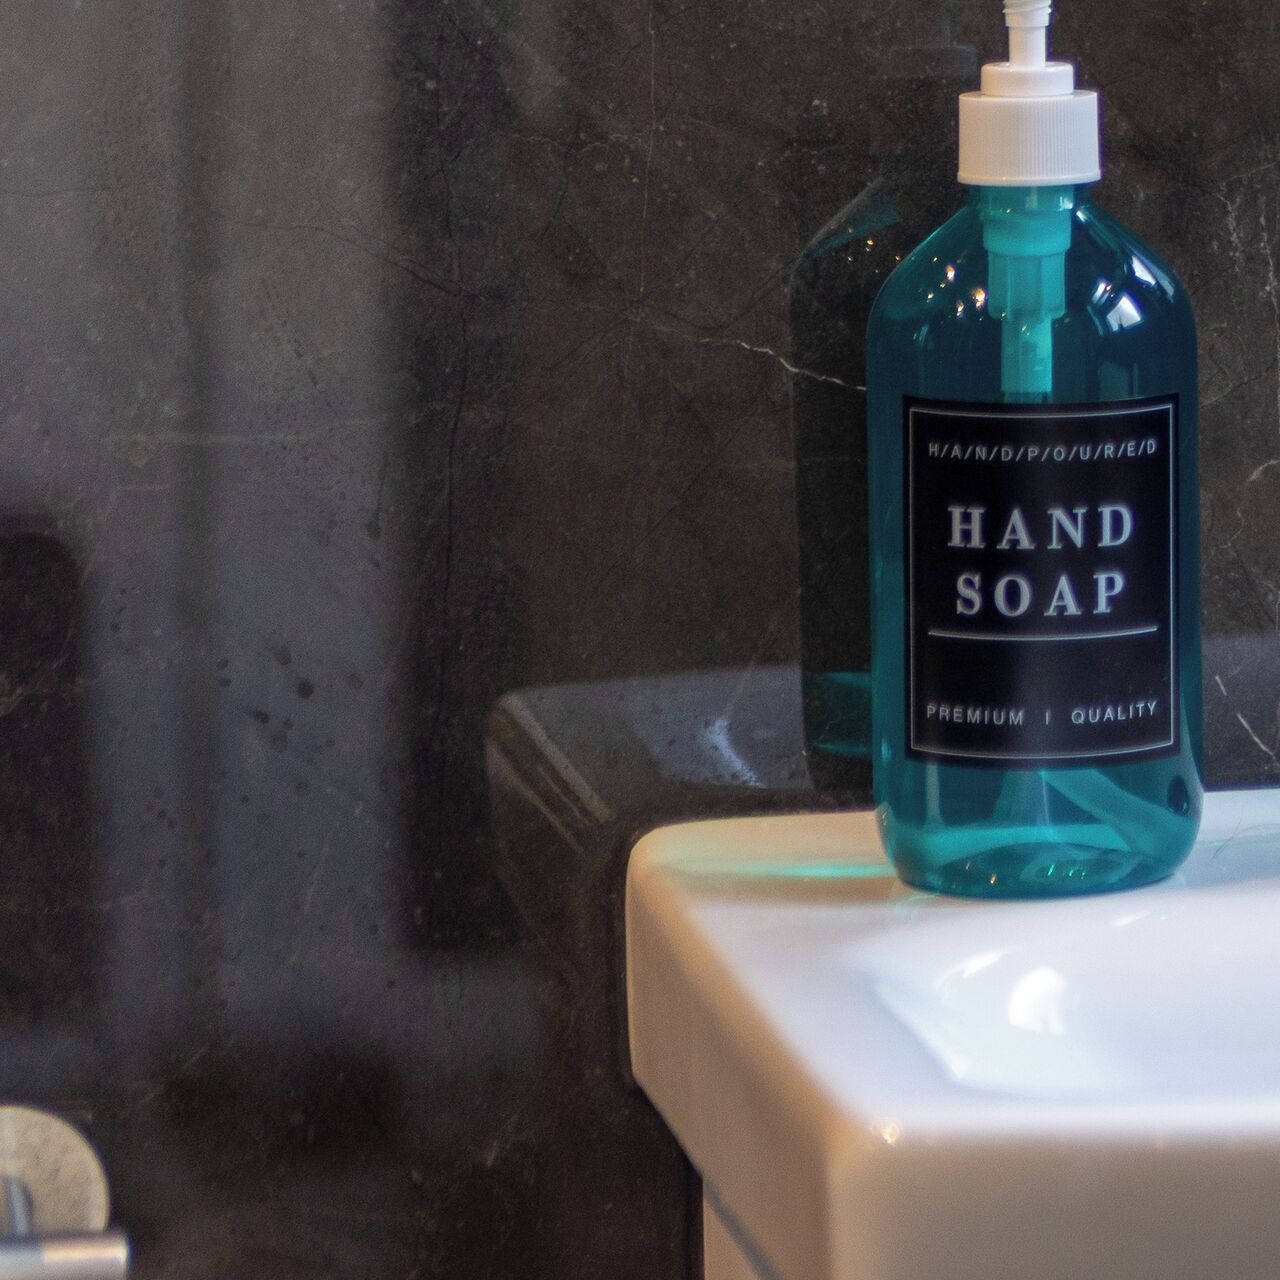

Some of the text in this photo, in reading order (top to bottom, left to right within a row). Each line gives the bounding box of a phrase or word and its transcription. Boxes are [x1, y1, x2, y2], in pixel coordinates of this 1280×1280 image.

[947, 505, 1134, 550] HAND
[956, 571, 1125, 617] SOAP
[926, 704, 1024, 726] PREMIUM
[1071, 700, 1157, 725] QUALITY
